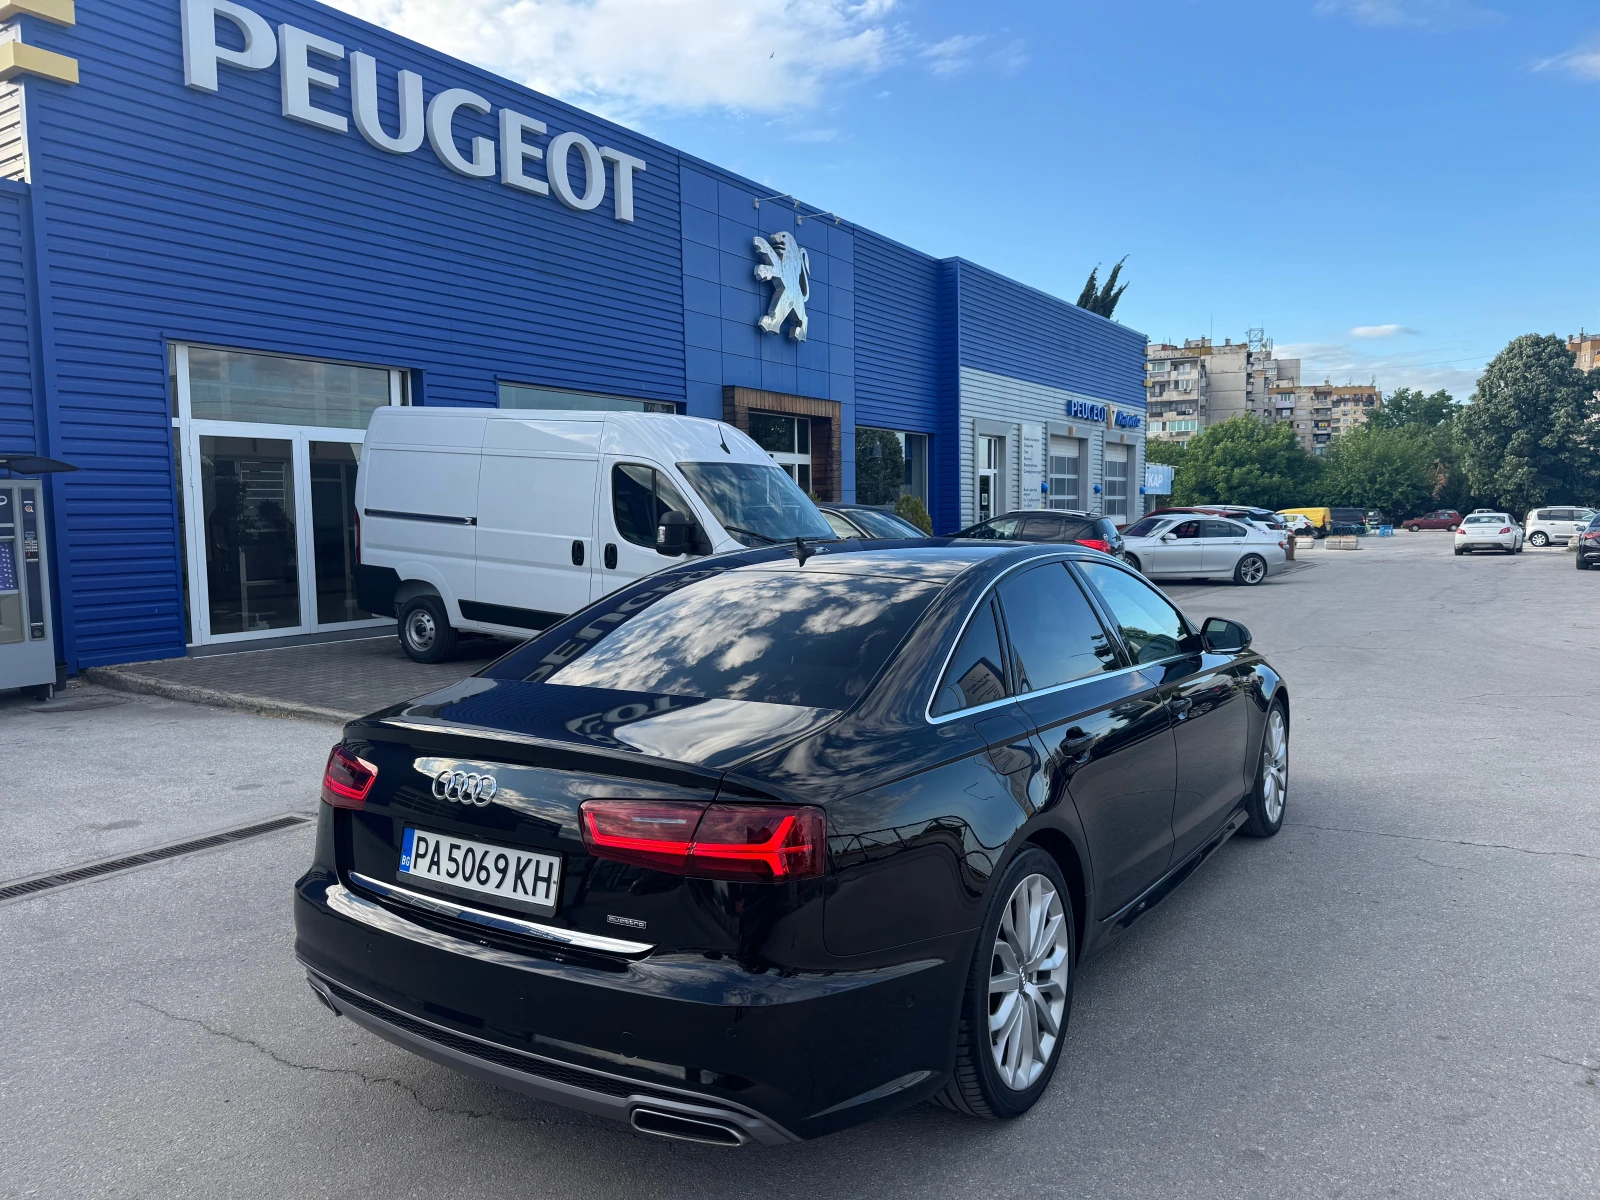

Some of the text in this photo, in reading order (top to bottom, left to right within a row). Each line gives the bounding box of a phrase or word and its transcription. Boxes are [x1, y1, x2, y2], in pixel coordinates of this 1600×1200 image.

[181, 0, 646, 222] PEUGEOT
[1069, 400, 1107, 422] PEUGEOT
[401, 855, 411, 867] BG
